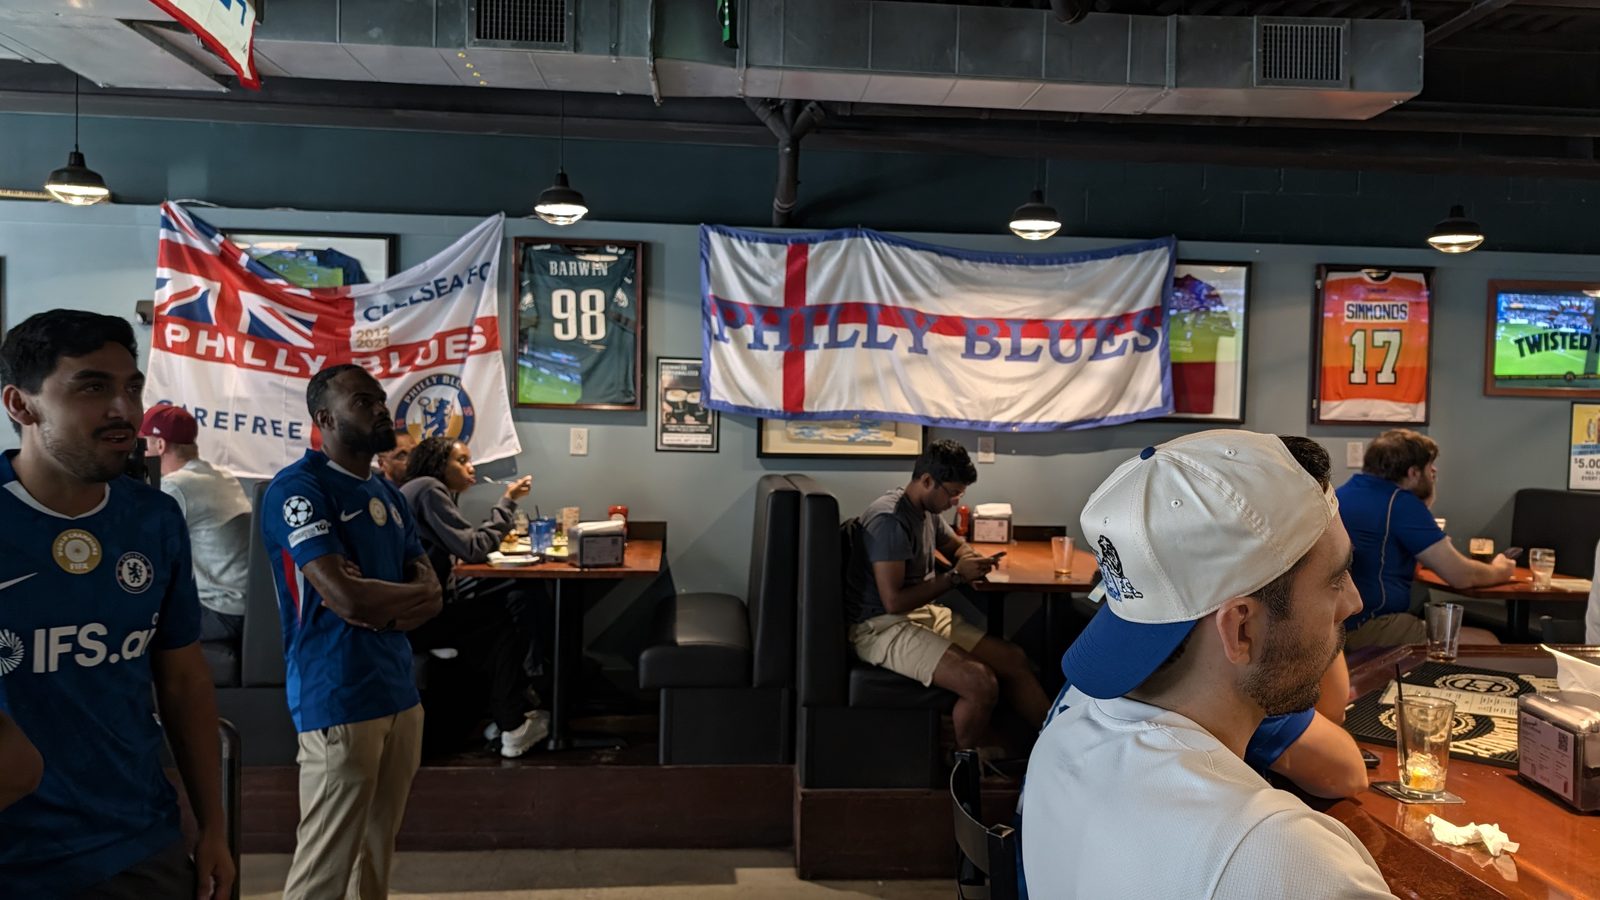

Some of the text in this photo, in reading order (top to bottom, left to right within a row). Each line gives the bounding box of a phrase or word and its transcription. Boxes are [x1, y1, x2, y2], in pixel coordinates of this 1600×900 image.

[549, 260, 609, 277] BARWIN
[363, 273, 465, 323] CLSEA
[551, 288, 607, 341] 98
[1346, 303, 1408, 320] SIMMONDS
[164, 322, 488, 376] PHILLY BLUES
[711, 296, 1160, 365] PHILLY BLUES
[1514, 331, 1592, 358] TWISTED
[1349, 328, 1402, 385] 17
[403, 375, 439, 405] PHILLY
[157, 400, 304, 441] REFREE
[33, 612, 159, 674] IFS.ai
